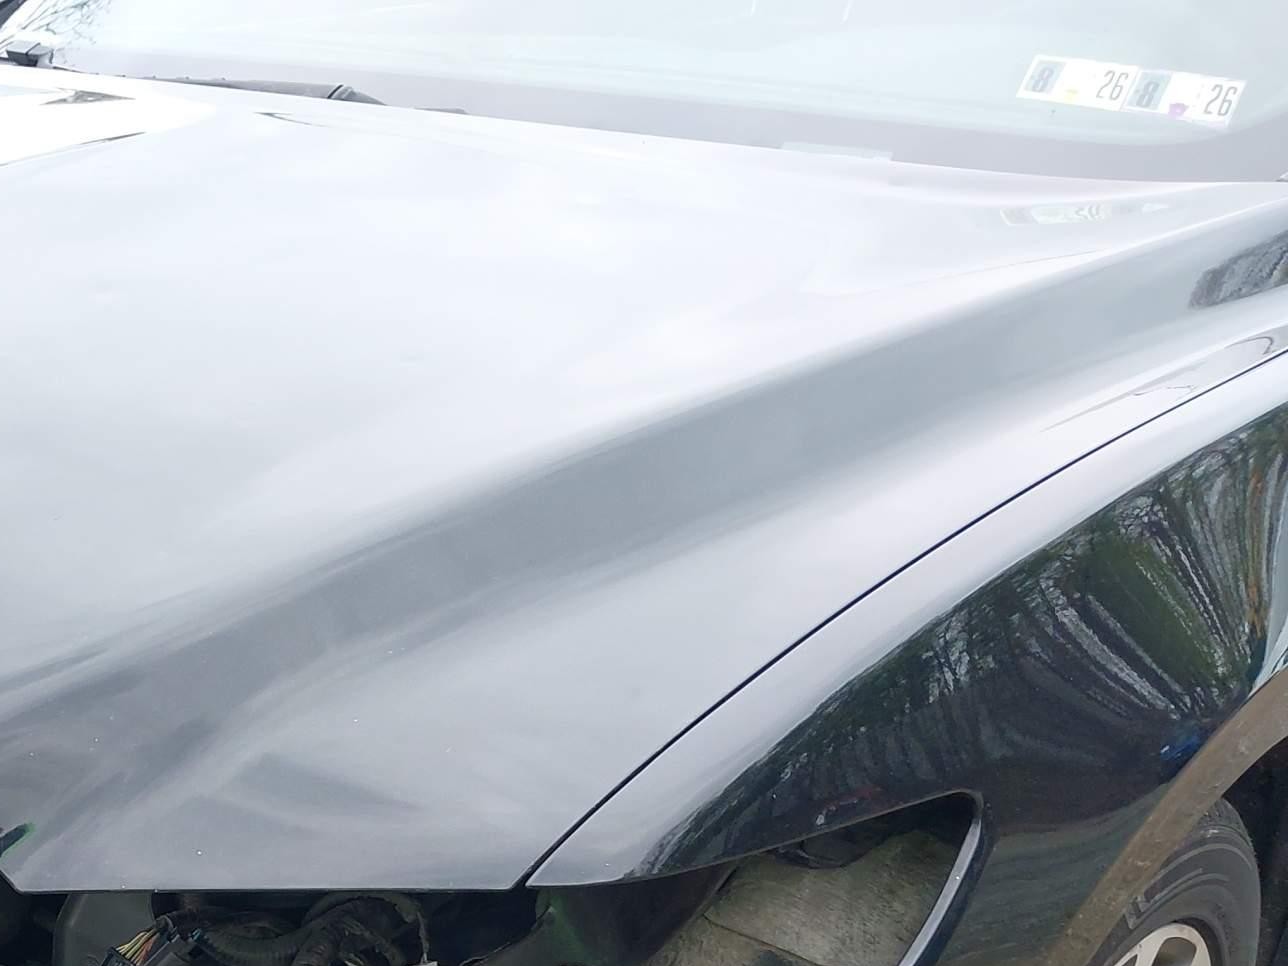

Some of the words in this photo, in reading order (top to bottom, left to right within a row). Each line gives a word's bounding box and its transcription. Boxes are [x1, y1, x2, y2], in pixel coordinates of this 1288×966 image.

[1031, 67, 1055, 93] 8
[1096, 70, 1129, 101] 26
[1137, 79, 1160, 108] 8
[1203, 84, 1237, 117] 26
